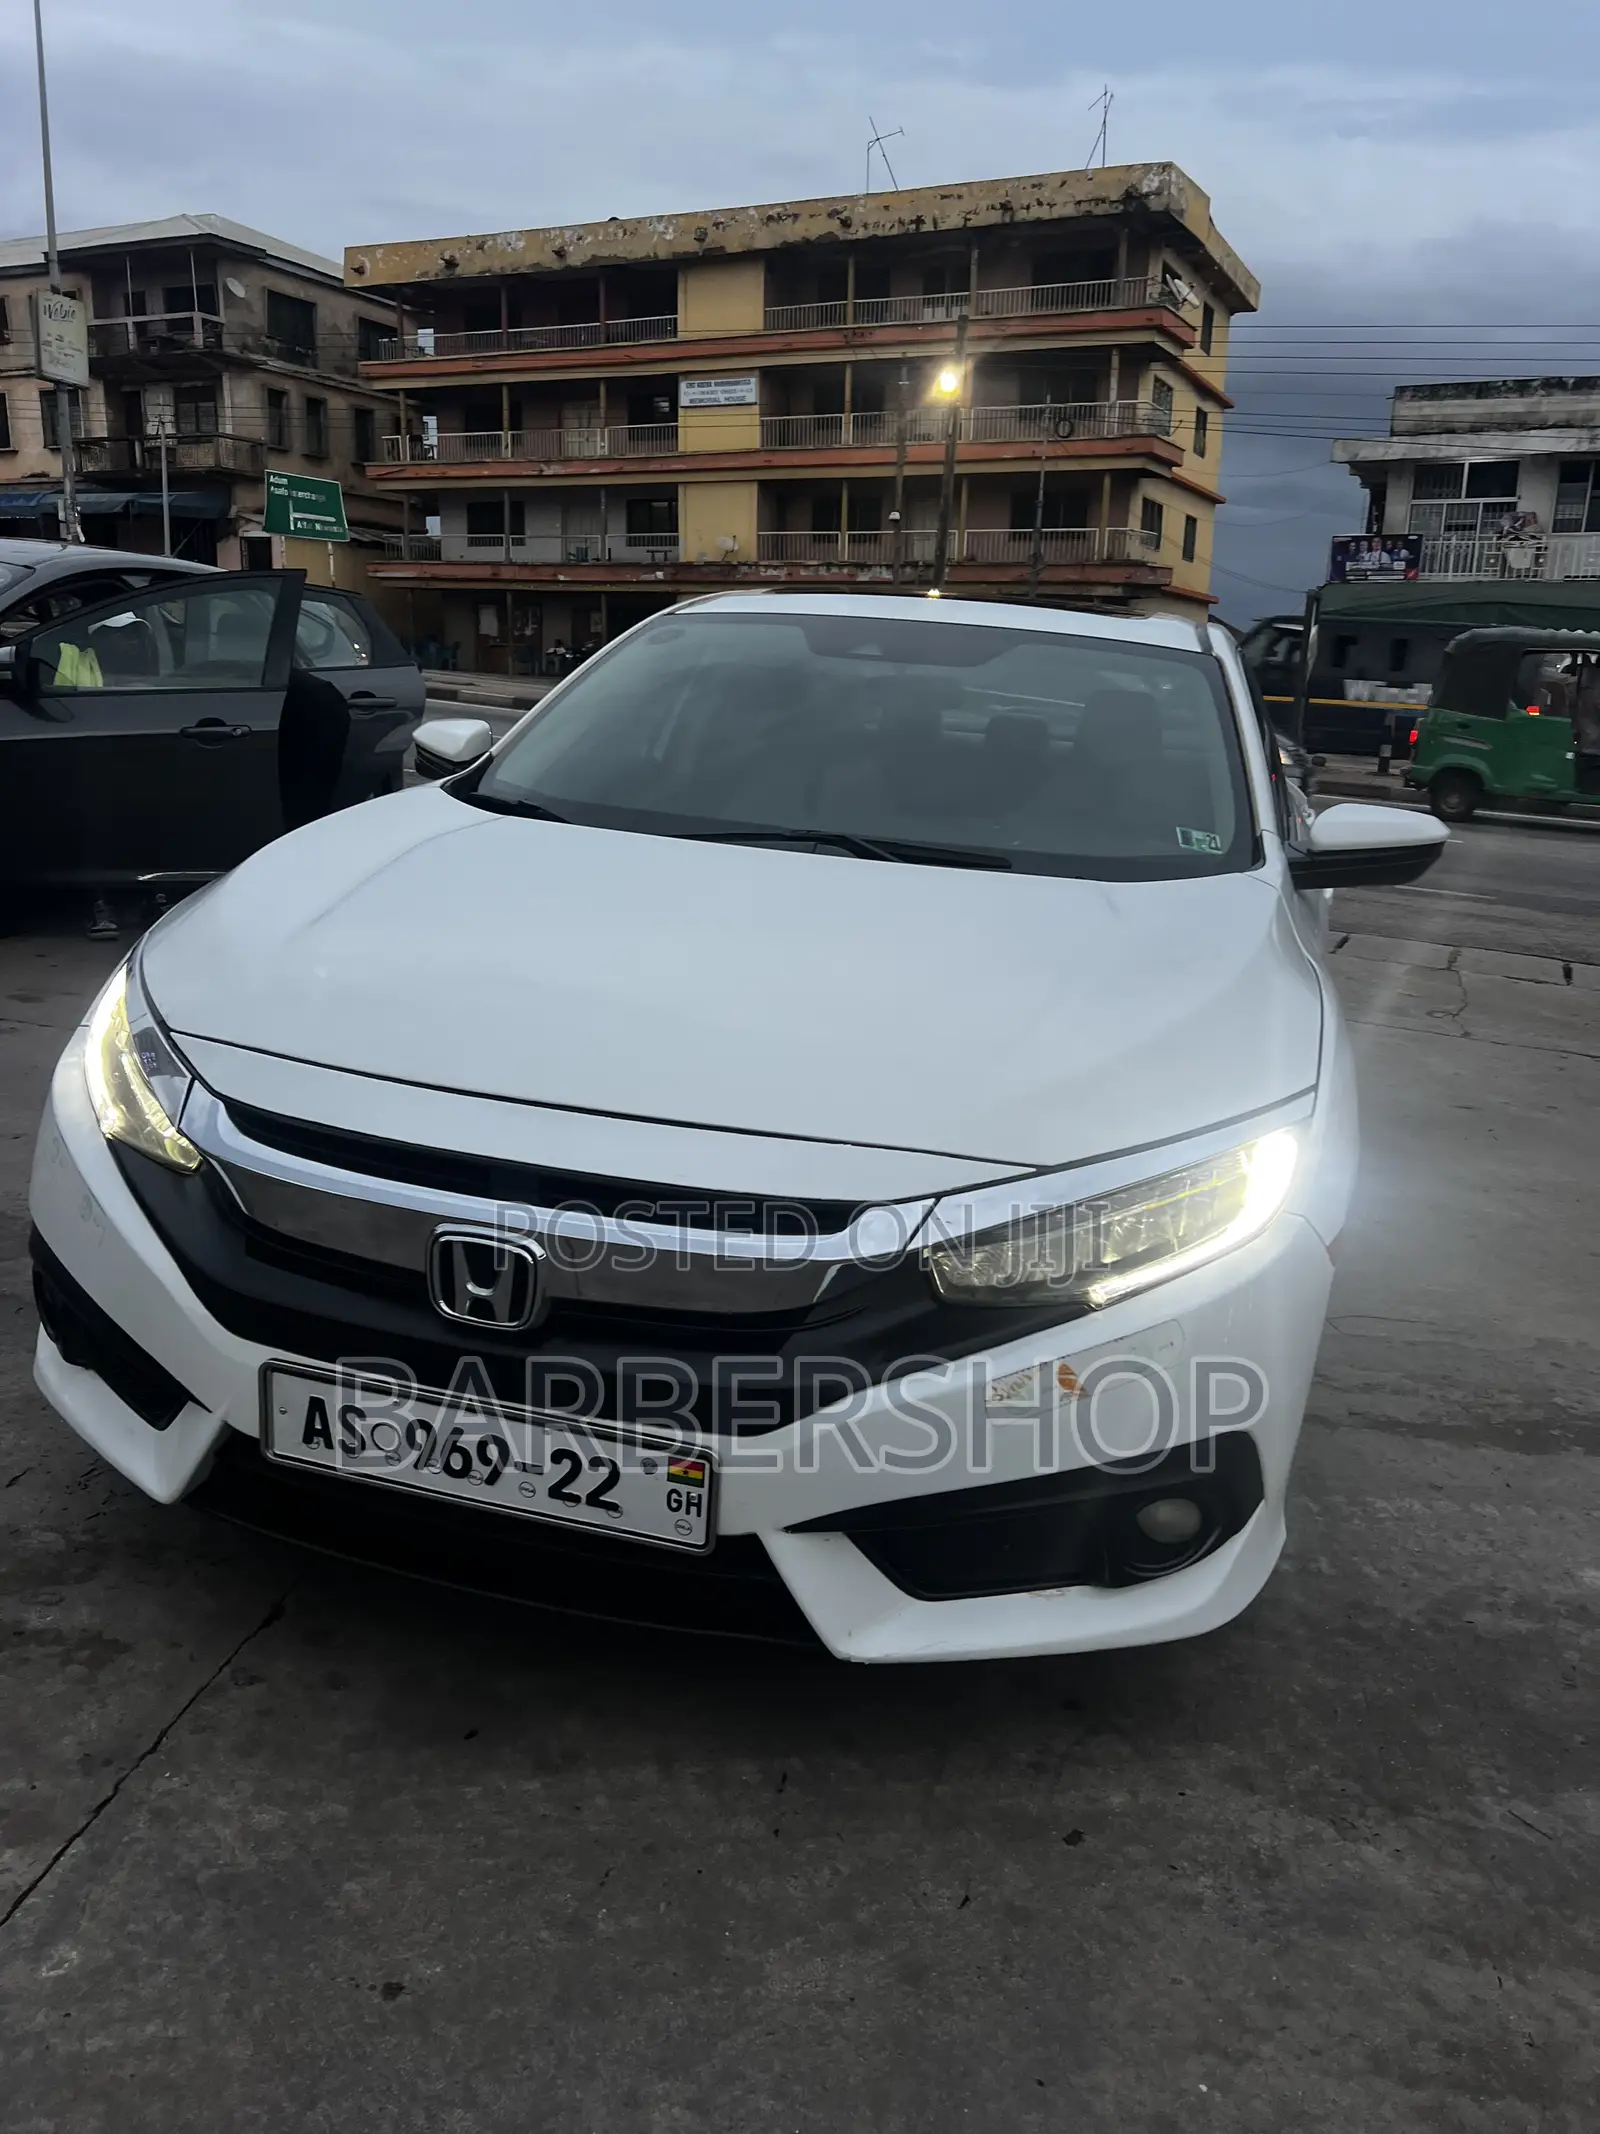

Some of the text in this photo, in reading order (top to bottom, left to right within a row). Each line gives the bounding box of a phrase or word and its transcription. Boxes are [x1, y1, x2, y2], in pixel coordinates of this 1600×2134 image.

[269, 475, 288, 485] Adum
[302, 1395, 366, 1455] AS
[666, 1488, 703, 1518] GH
